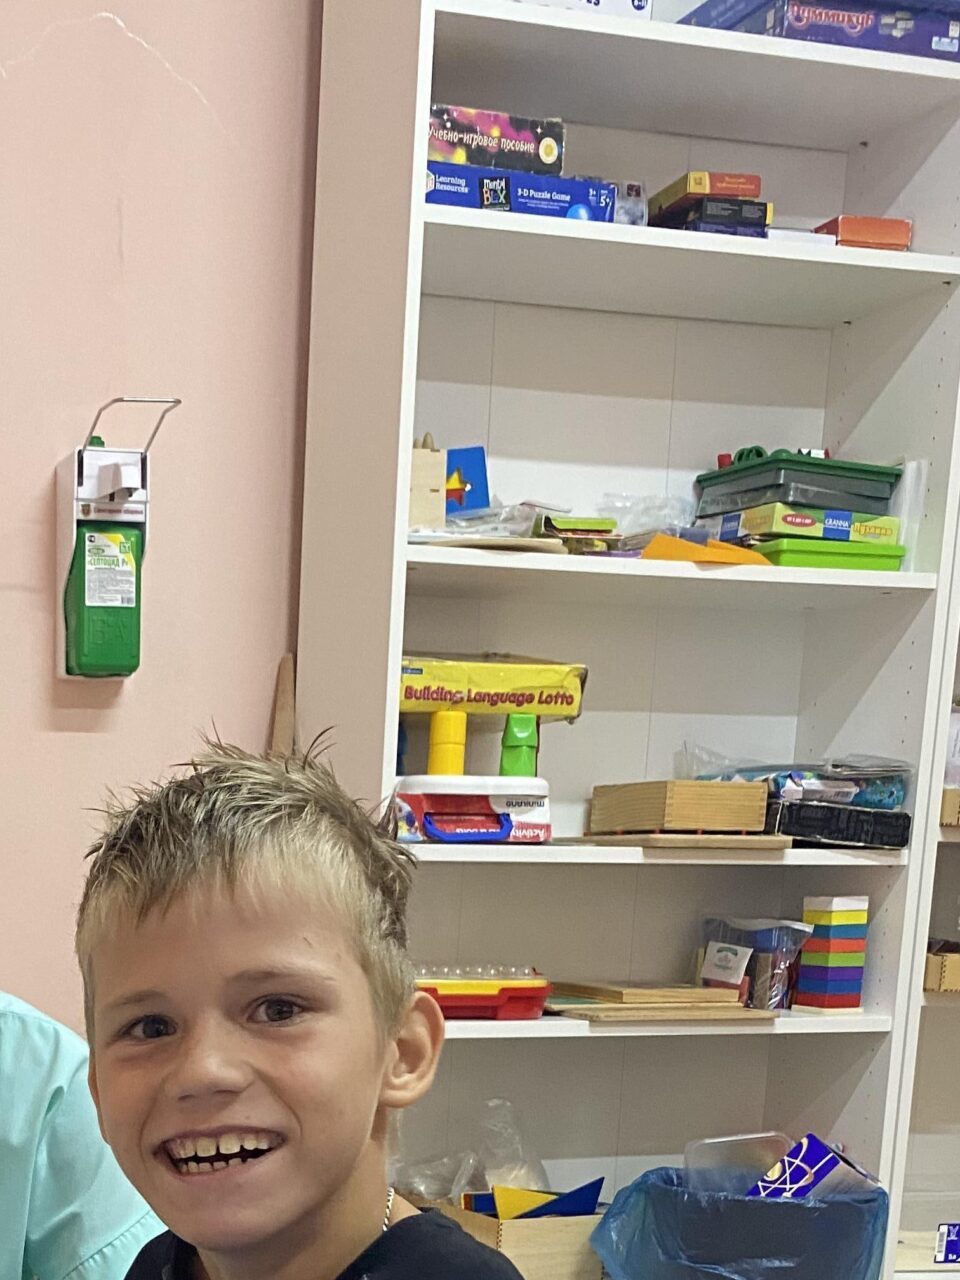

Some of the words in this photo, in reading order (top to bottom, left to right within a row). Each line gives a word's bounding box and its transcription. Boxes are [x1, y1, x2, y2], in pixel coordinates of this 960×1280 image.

[428, 126, 499, 149] Учебно-игровое
[500, 137, 536, 153] пособие
[435, 174, 466, 187] Learning
[435, 183, 469, 194] Resources
[530, 190, 551, 200] Puzzle
[551, 191, 571, 201] Game
[466, 688, 536, 707] Language
[537, 690, 575, 706] Lotto
[511, 827, 545, 838] Activity
